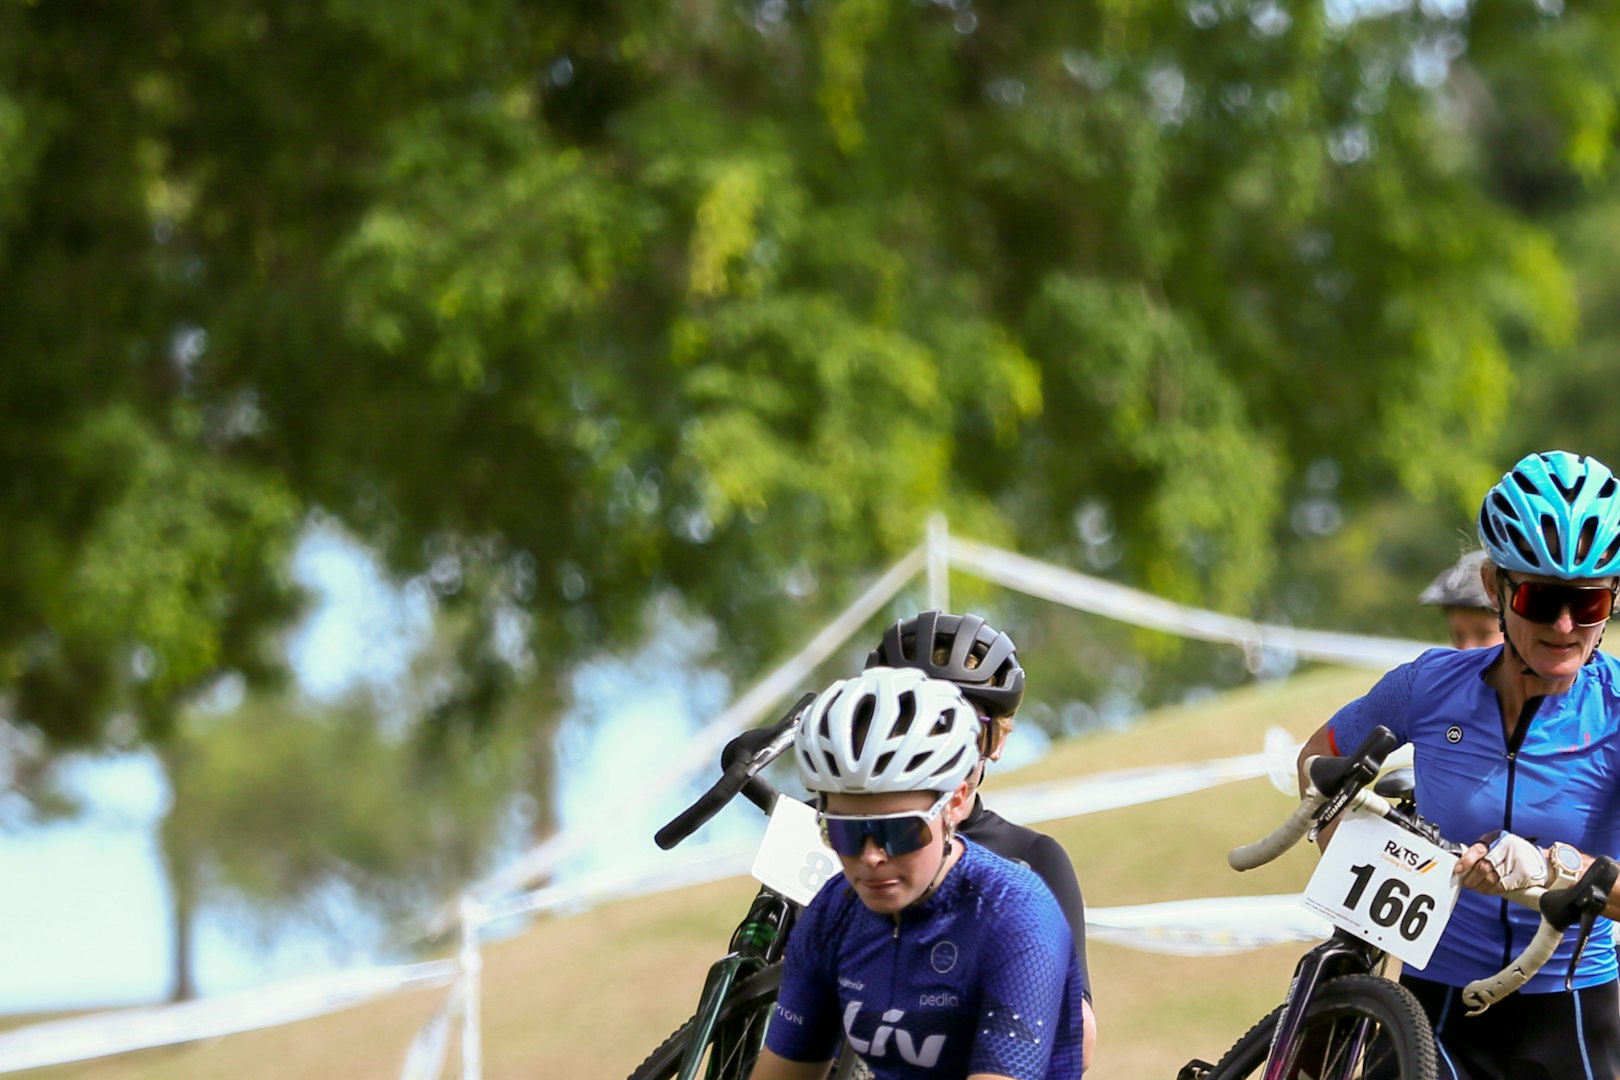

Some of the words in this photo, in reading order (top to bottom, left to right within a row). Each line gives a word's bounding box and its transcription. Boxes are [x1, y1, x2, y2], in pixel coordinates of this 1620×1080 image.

[1383, 840, 1420, 867] RATS
[1342, 863, 1436, 942] 166
[843, 1001, 947, 1068] Liv
